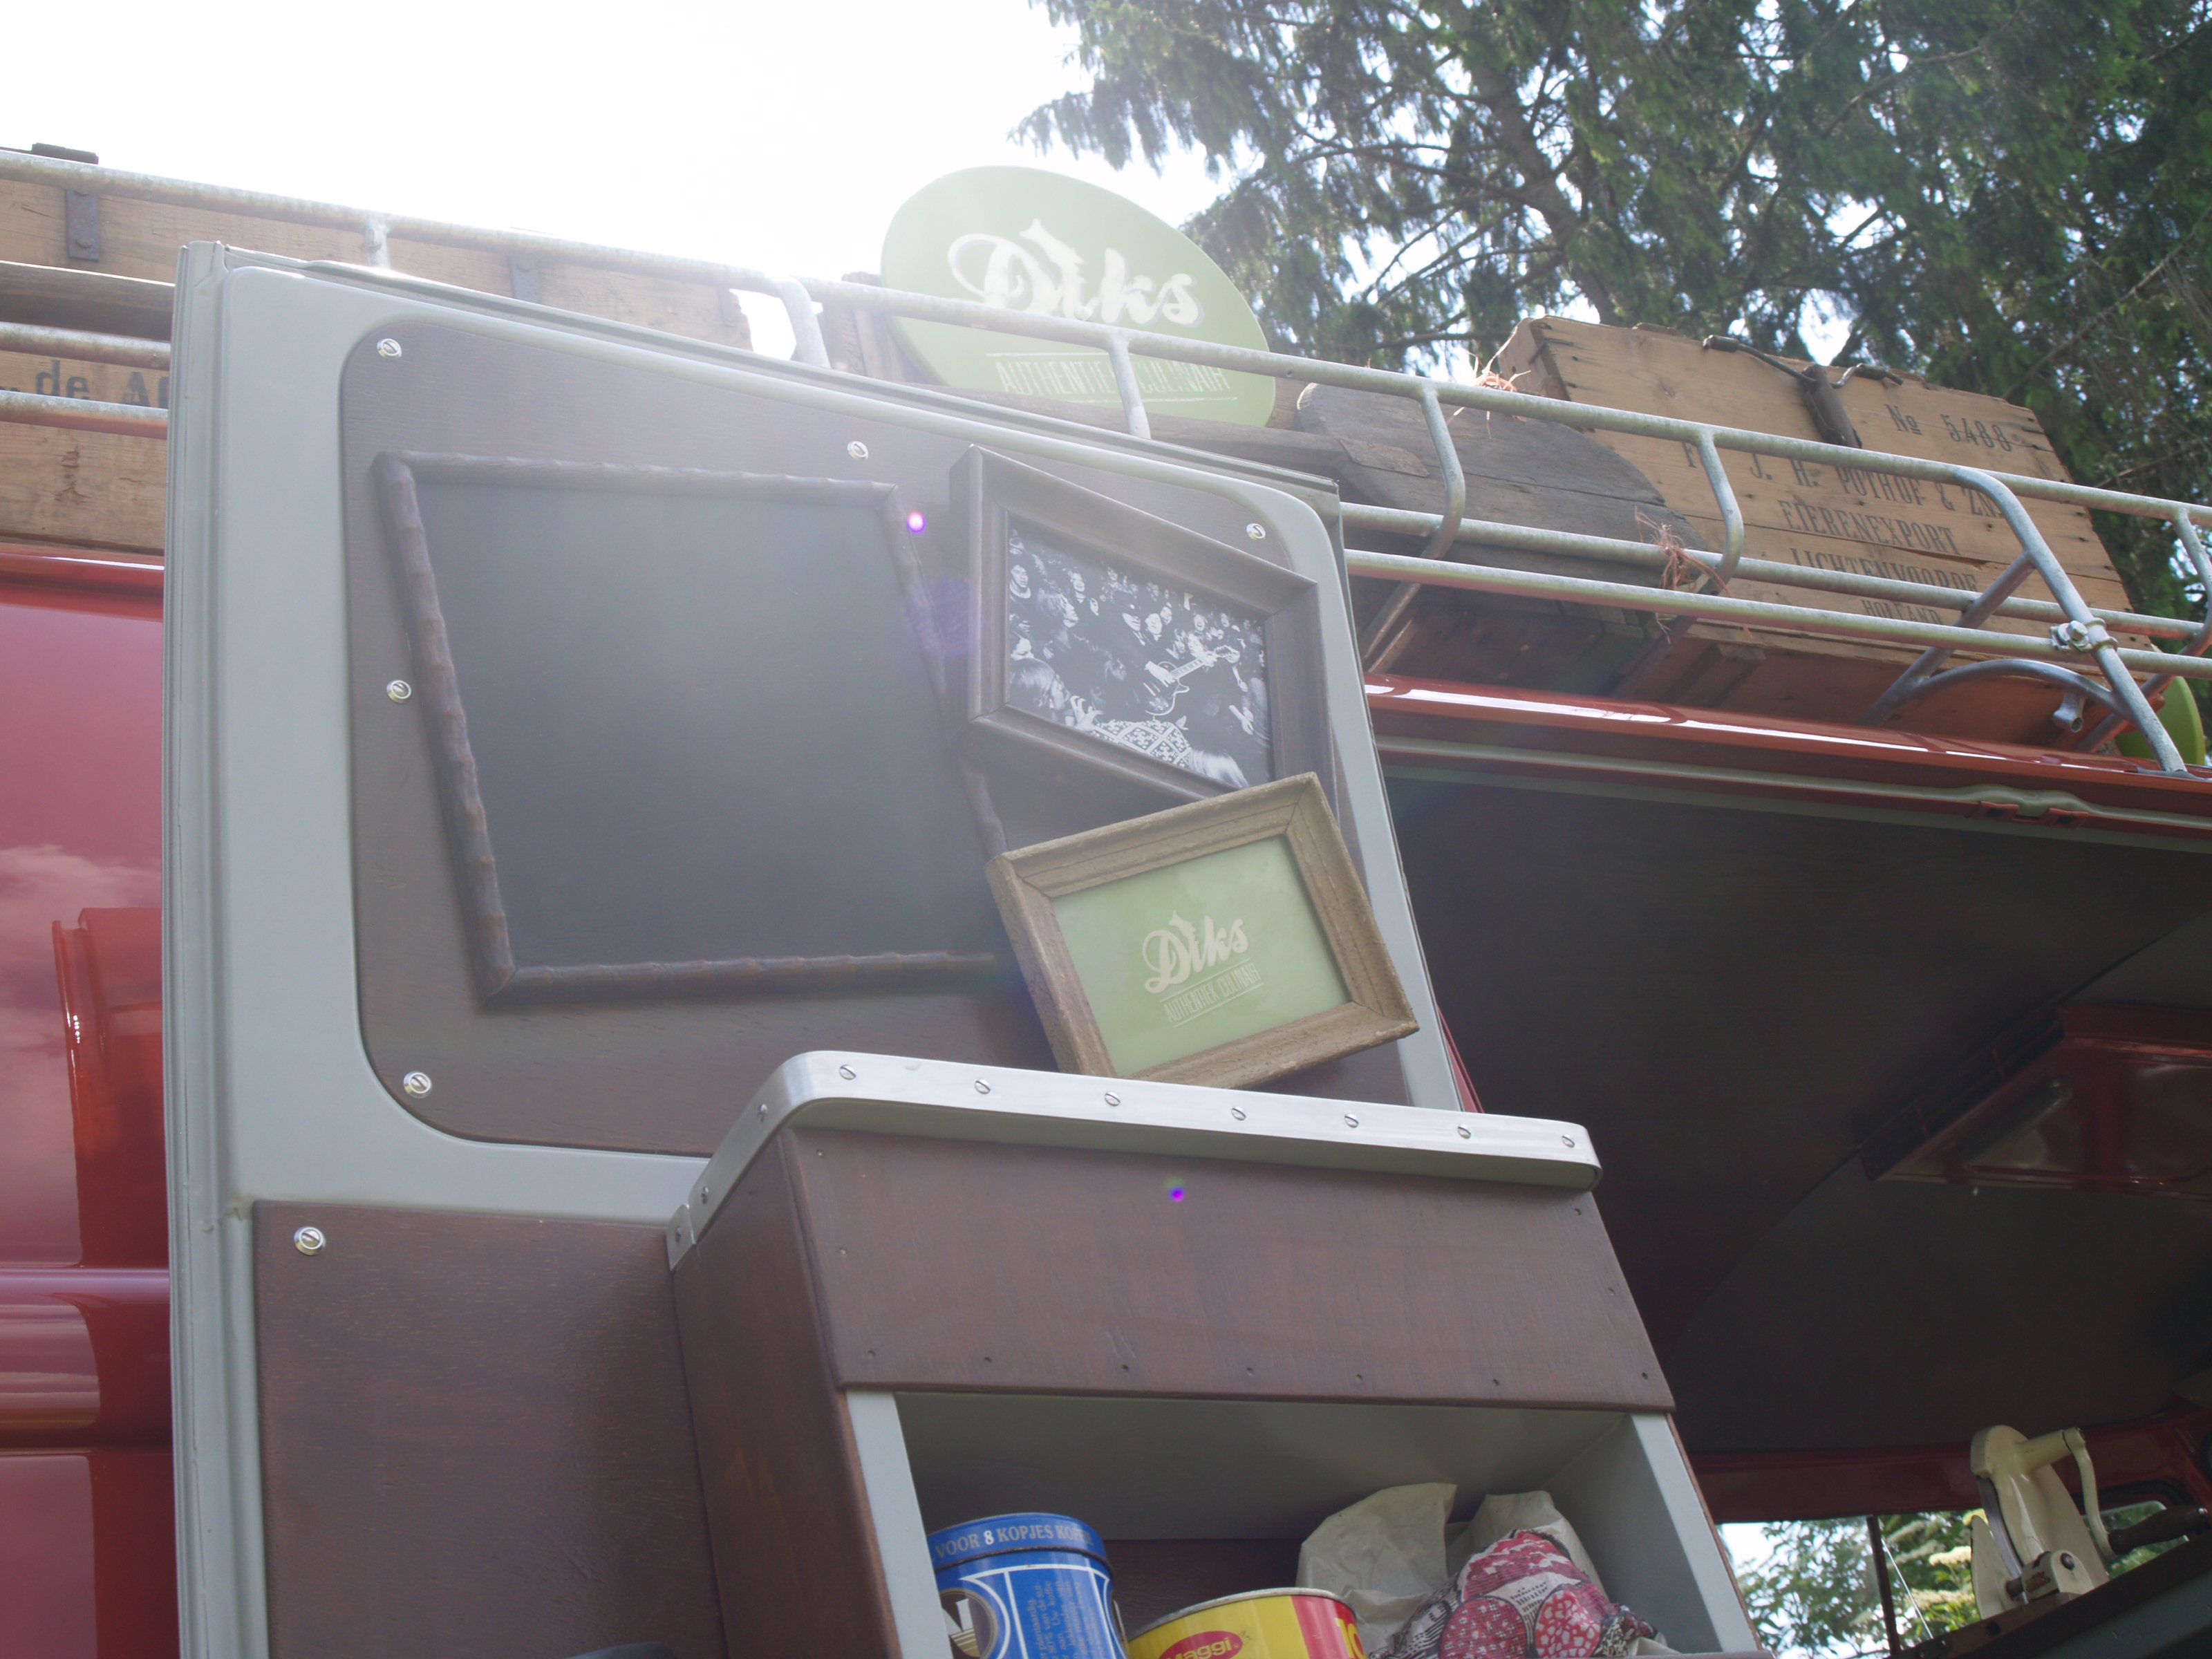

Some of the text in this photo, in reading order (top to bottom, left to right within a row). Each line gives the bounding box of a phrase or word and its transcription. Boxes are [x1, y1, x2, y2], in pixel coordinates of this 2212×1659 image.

[1940, 413, 2012, 452] 5488
[1778, 499, 1961, 556] EIERENEXPORT
[1142, 909, 1249, 994] Diks
[1163, 962, 1262, 1024] AUTHENTIEK CULINAIR
[934, 1533, 981, 1559] VOOR
[983, 1530, 995, 1545] 8
[995, 1524, 1054, 1543] KOPJES
